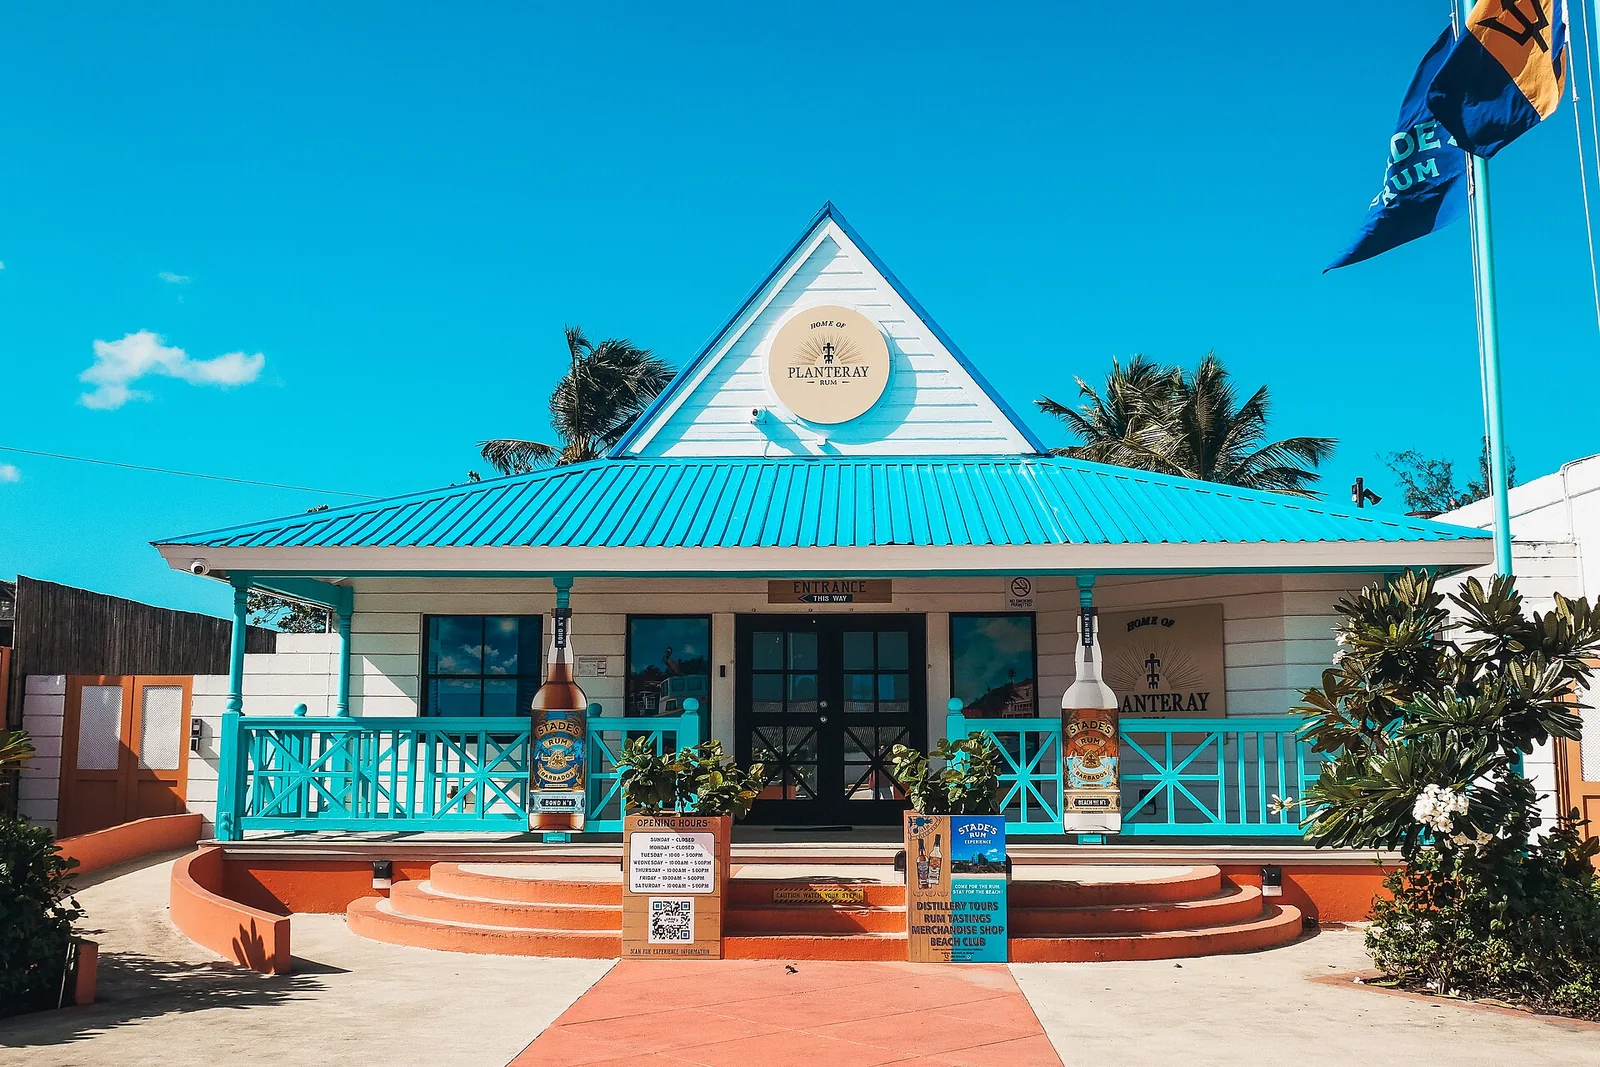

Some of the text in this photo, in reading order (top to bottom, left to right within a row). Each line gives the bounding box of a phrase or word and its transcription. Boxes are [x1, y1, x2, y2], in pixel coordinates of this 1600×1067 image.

[810, 320, 834, 330] HOME
[788, 366, 870, 378] PLANTERAY
[794, 581, 866, 593] ENTRANCE
[1127, 616, 1175, 632] HOME OF
[1118, 692, 1210, 713] ANTERAY
[538, 722, 580, 735] STADE'S
[1070, 721, 1112, 734] STADE'S
[541, 771, 574, 781] BARBADOS
[1075, 770, 1108, 780] BARBADOS
[637, 819, 708, 828] OPENING HOURS
[958, 823, 998, 835] STADE'S
[916, 902, 999, 910] DISTILLERY TOURS
[924, 914, 991, 923] RUM TASTINGS
[912, 926, 1004, 934] MERCHANDISE SHOP
[931, 938, 986, 946] BEACH CLUB
